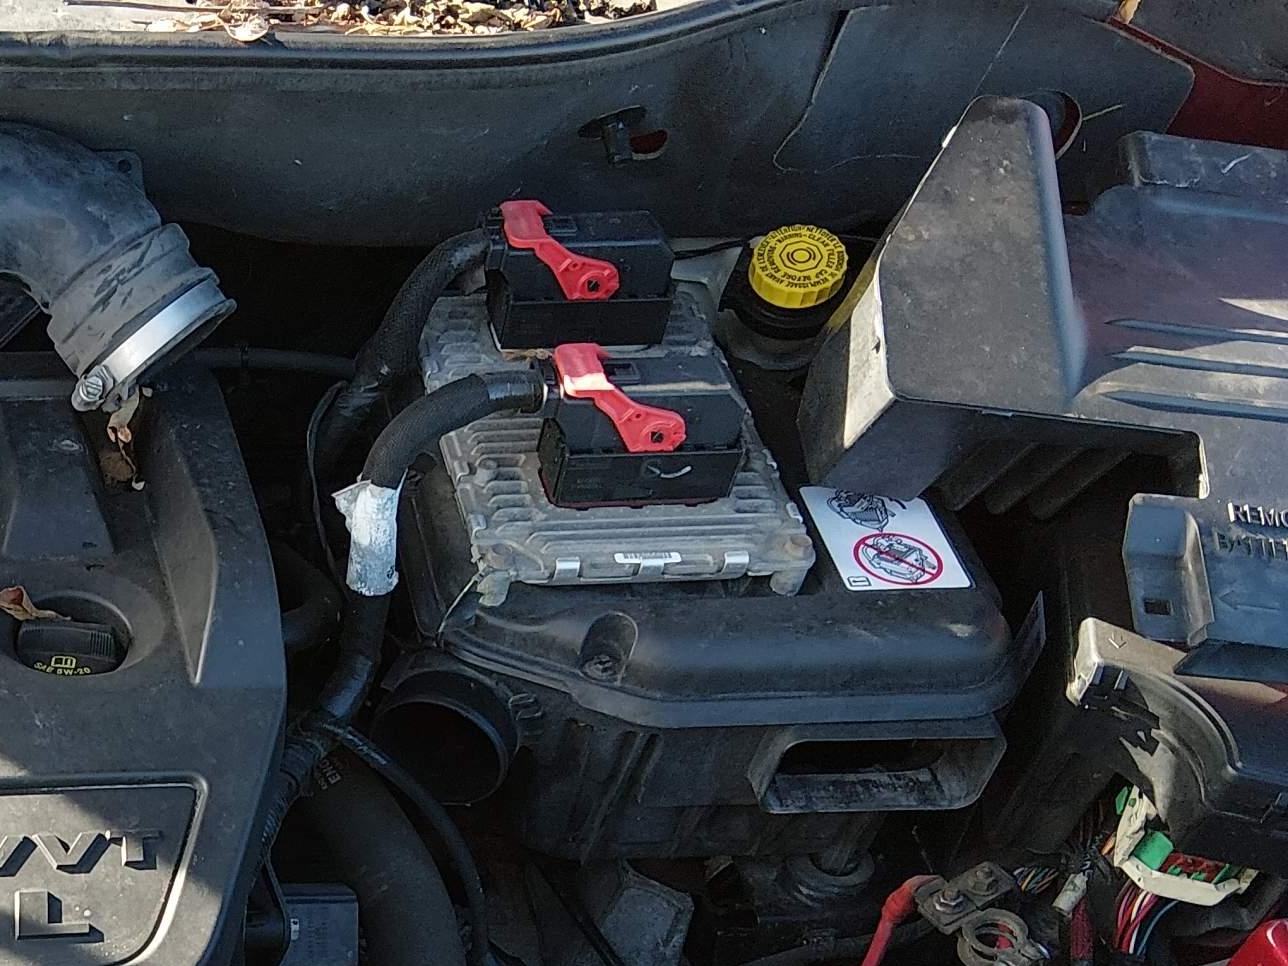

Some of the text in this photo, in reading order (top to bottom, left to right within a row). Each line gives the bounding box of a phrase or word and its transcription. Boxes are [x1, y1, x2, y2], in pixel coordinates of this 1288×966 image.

[807, 233, 830, 247] CLEAN
[825, 248, 835, 269] FILLER
[781, 271, 811, 282] BEFORE
[1214, 531, 1288, 560] BATTE
[33, 662, 91, 676] SAE 5W-20
